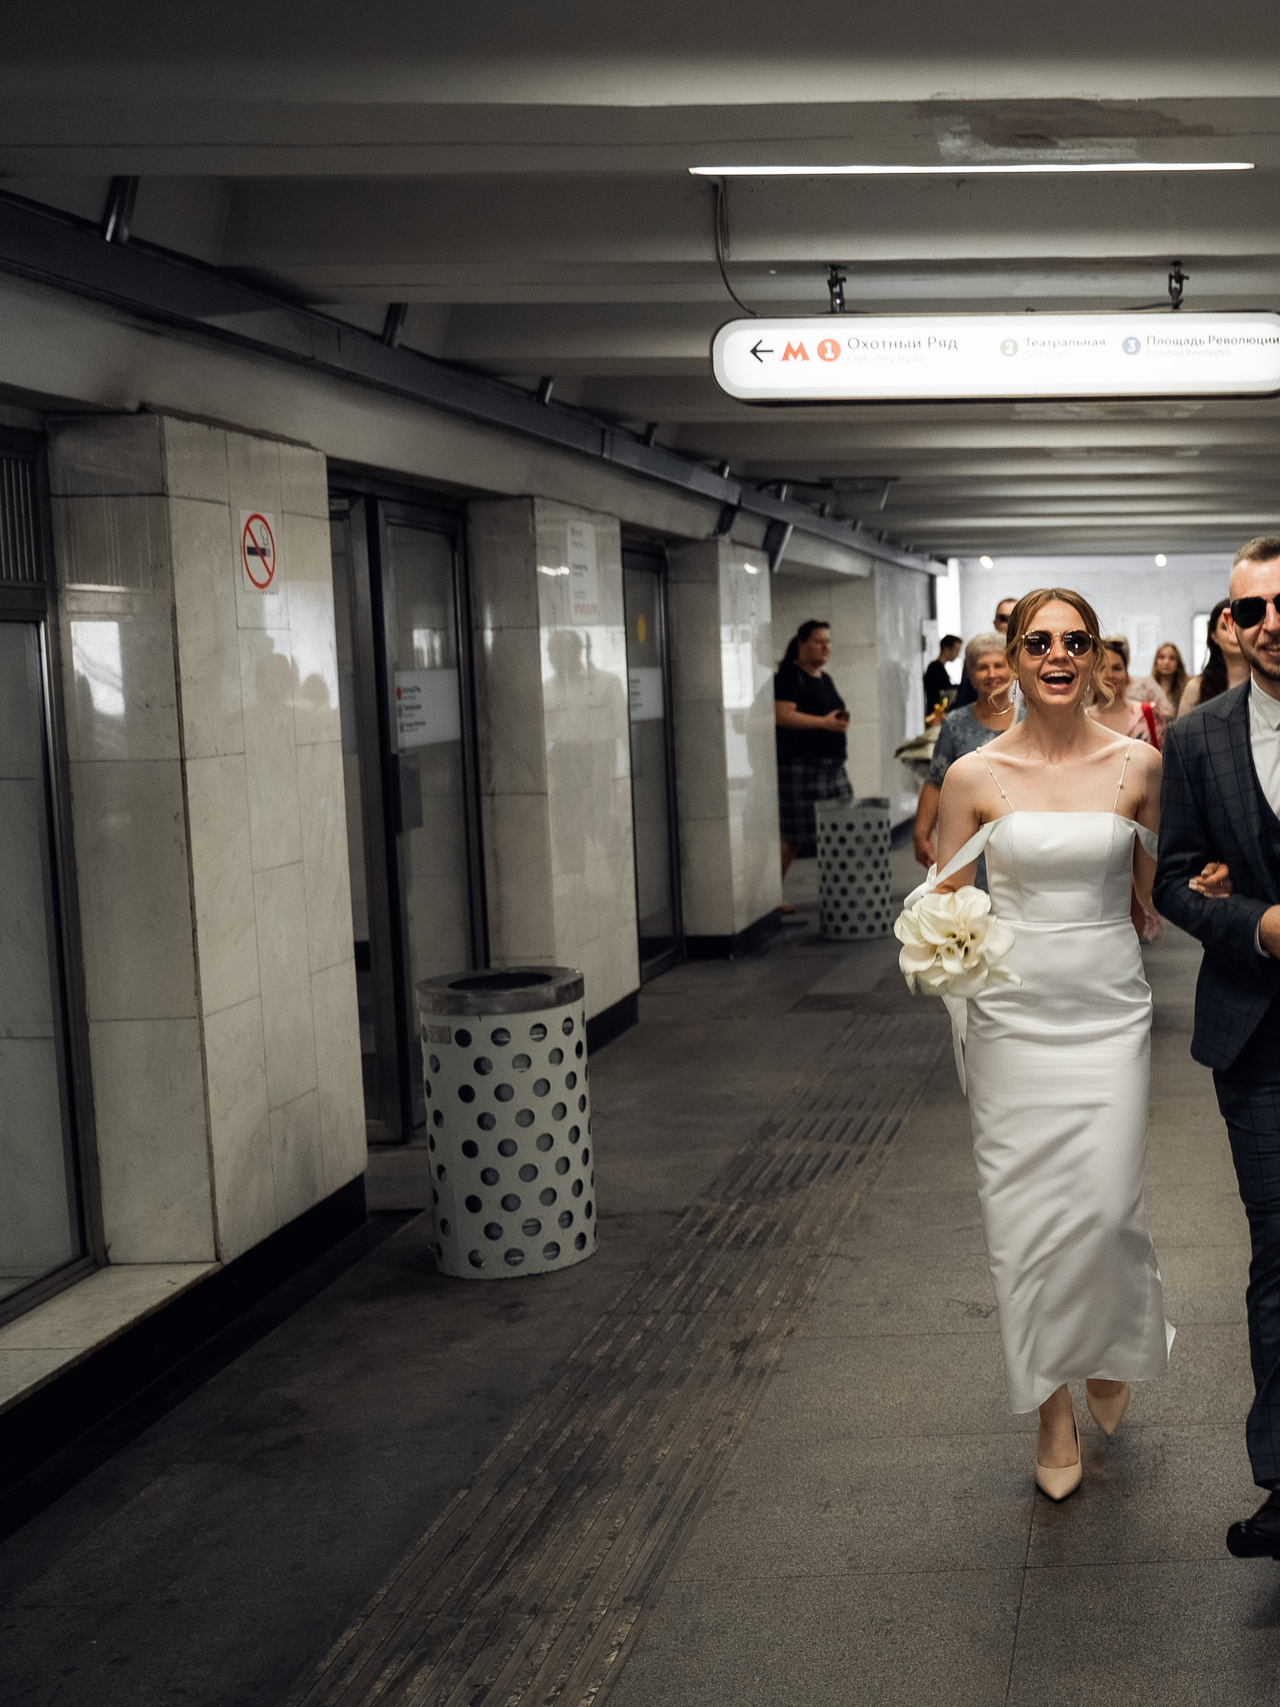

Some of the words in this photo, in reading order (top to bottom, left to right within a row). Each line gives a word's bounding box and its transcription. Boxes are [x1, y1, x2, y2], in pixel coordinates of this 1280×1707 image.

[848, 336, 922, 350] Охотный
[928, 336, 959, 350] Ряд
[1024, 337, 1106, 349] Театральная
[1146, 335, 1206, 347] Площадь
[1208, 335, 1280, 347] Революции
